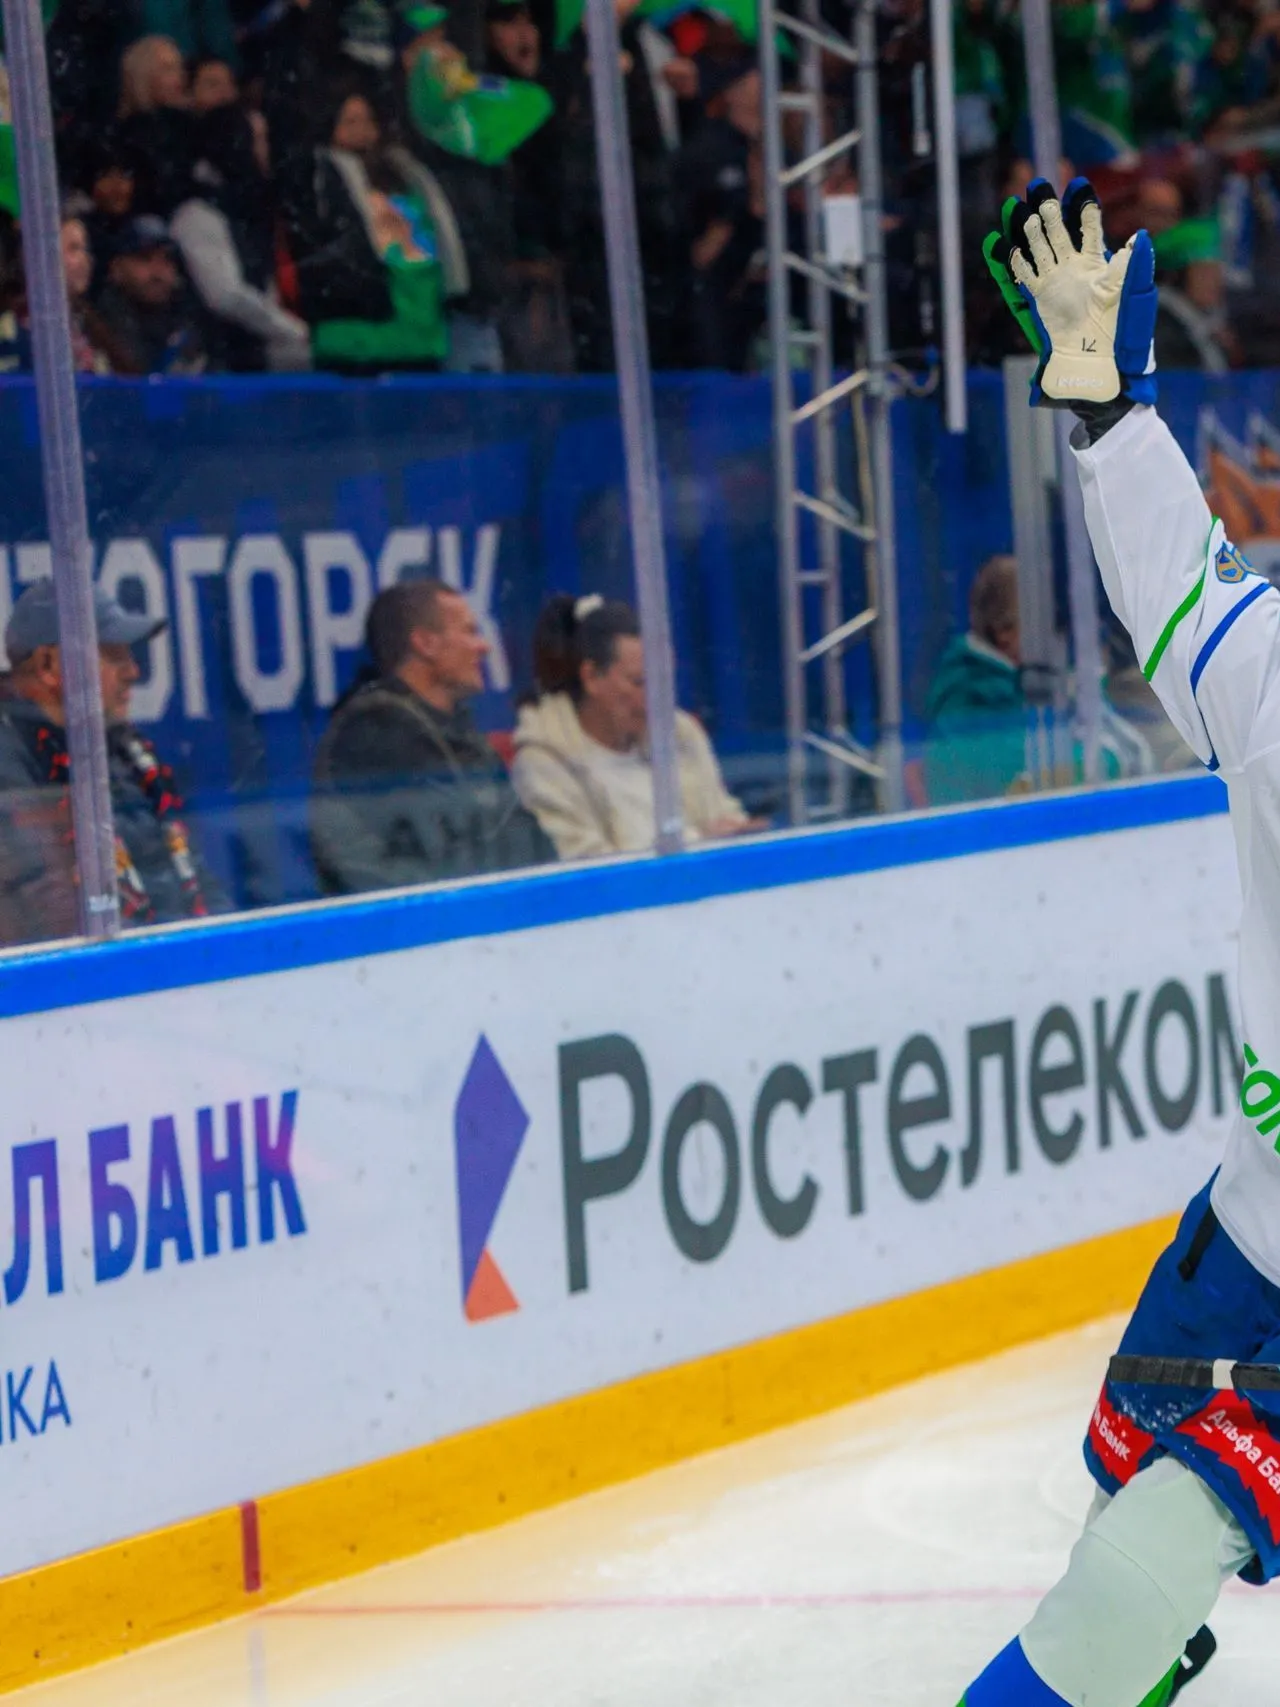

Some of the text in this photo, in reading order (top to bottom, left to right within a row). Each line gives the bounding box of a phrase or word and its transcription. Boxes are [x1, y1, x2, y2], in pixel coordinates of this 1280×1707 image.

[0, 1088, 307, 1307] Л БАНК
[0, 1356, 72, 1445] КА
[1206, 1408, 1262, 1465] Альфа
